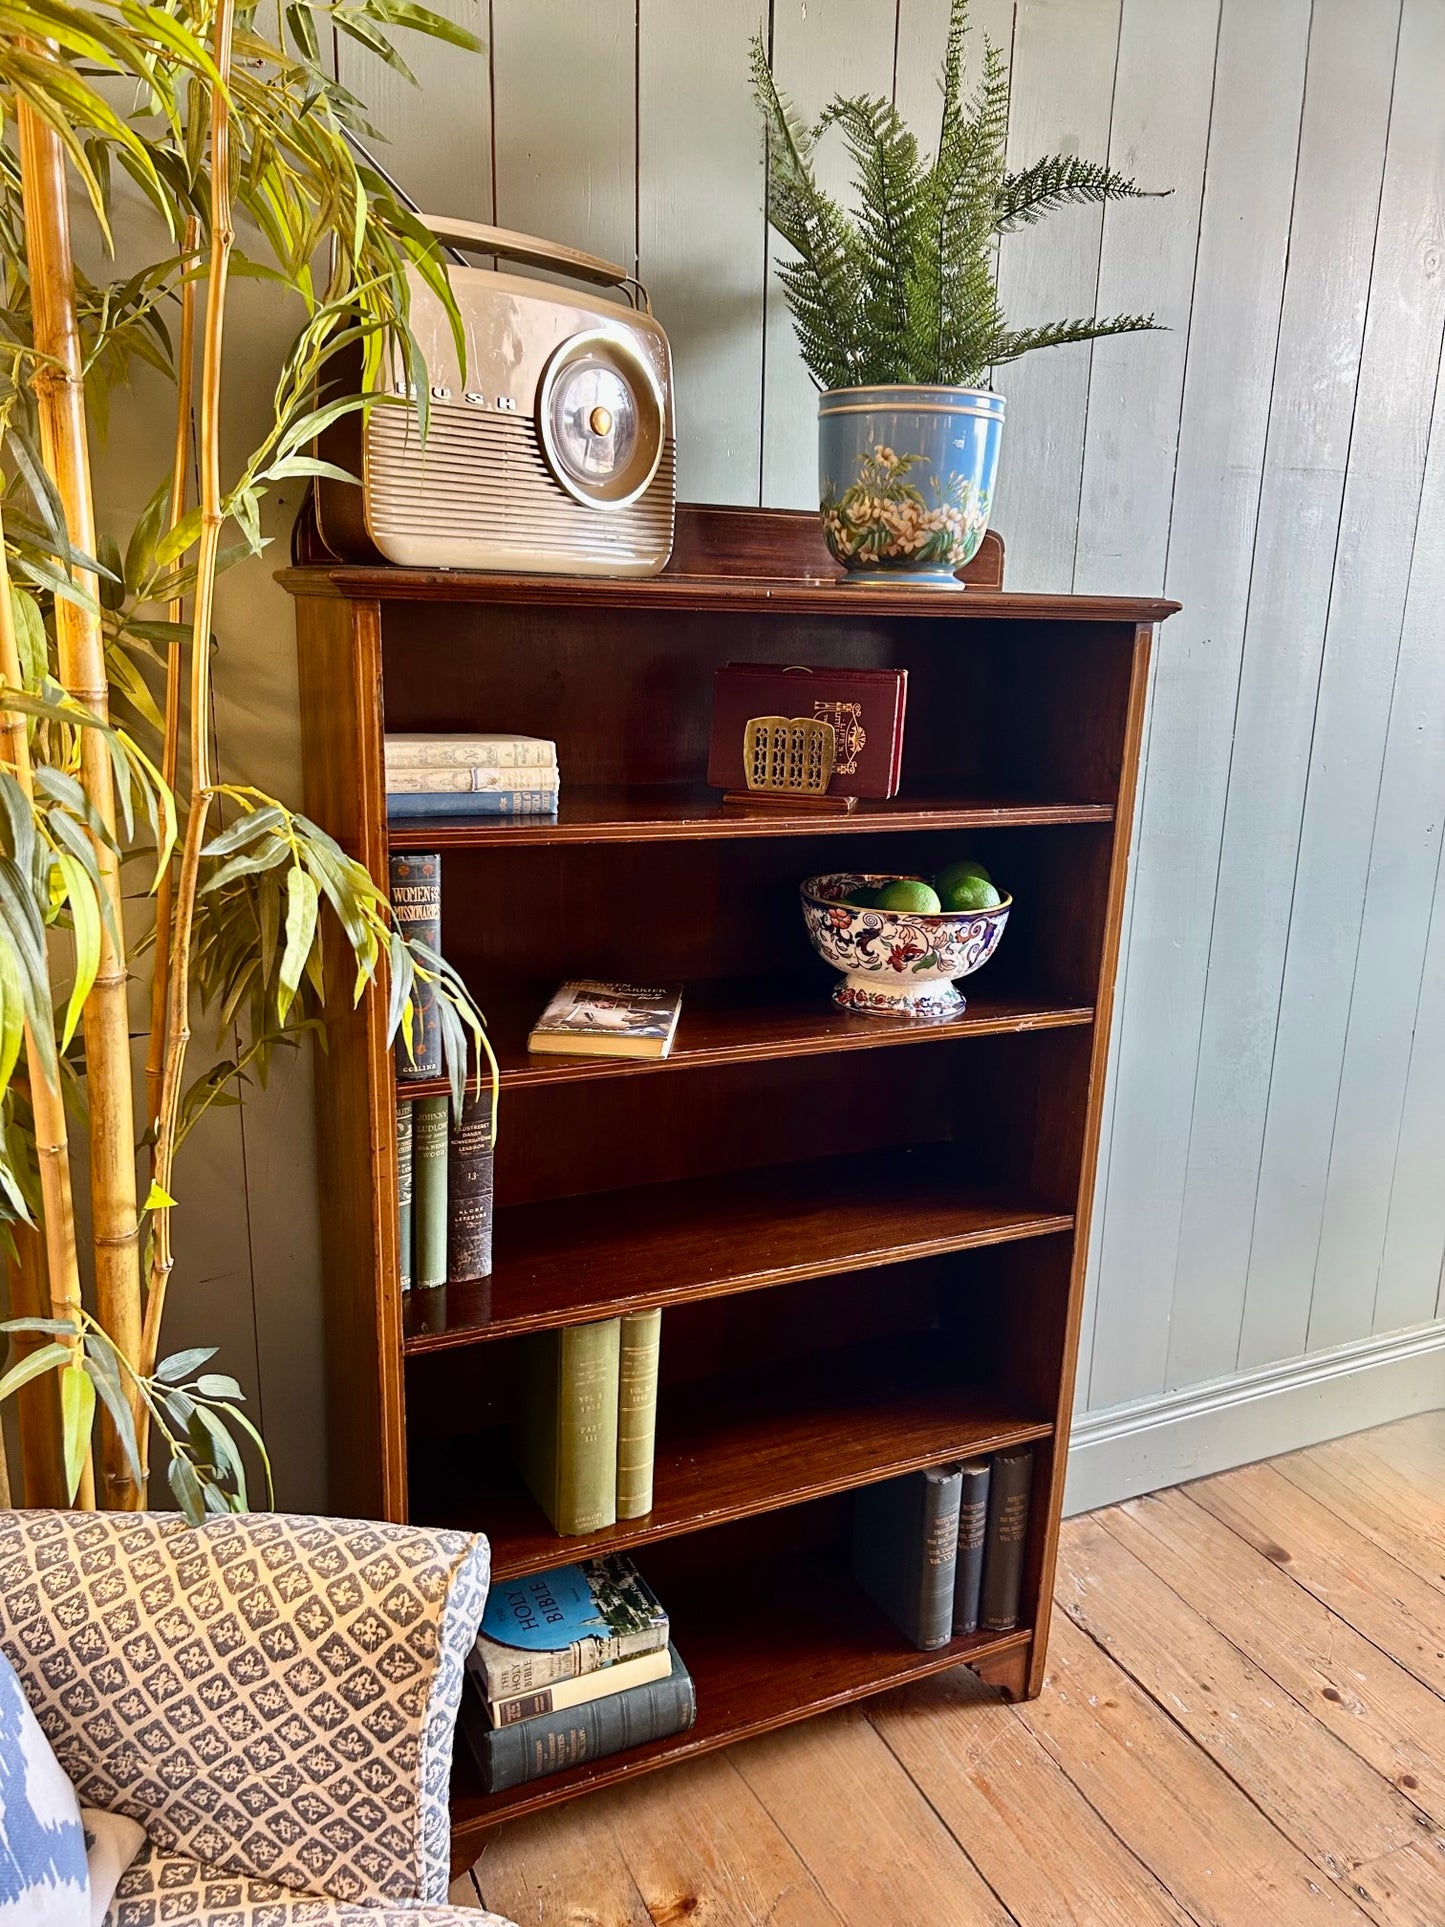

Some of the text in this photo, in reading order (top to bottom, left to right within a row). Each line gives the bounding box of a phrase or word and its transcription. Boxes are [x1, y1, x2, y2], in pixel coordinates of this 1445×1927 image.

[396, 381, 516, 411] BUSH
[838, 722, 847, 752] LIFE'S
[391, 886, 431, 903] WOMEN
[392, 903, 440, 922] MISSIONARIES
[417, 1110, 448, 1121] JOHNNY
[417, 1121, 448, 1133] LUDLOW
[423, 1150, 445, 1158] WOOD
[504, 1590, 540, 1631] HOLY
[528, 1581, 565, 1625] BIBLE
[501, 1670, 510, 1690] THE
[511, 1663, 521, 1691] HOLY
[523, 1659, 533, 1688] BIBLE
